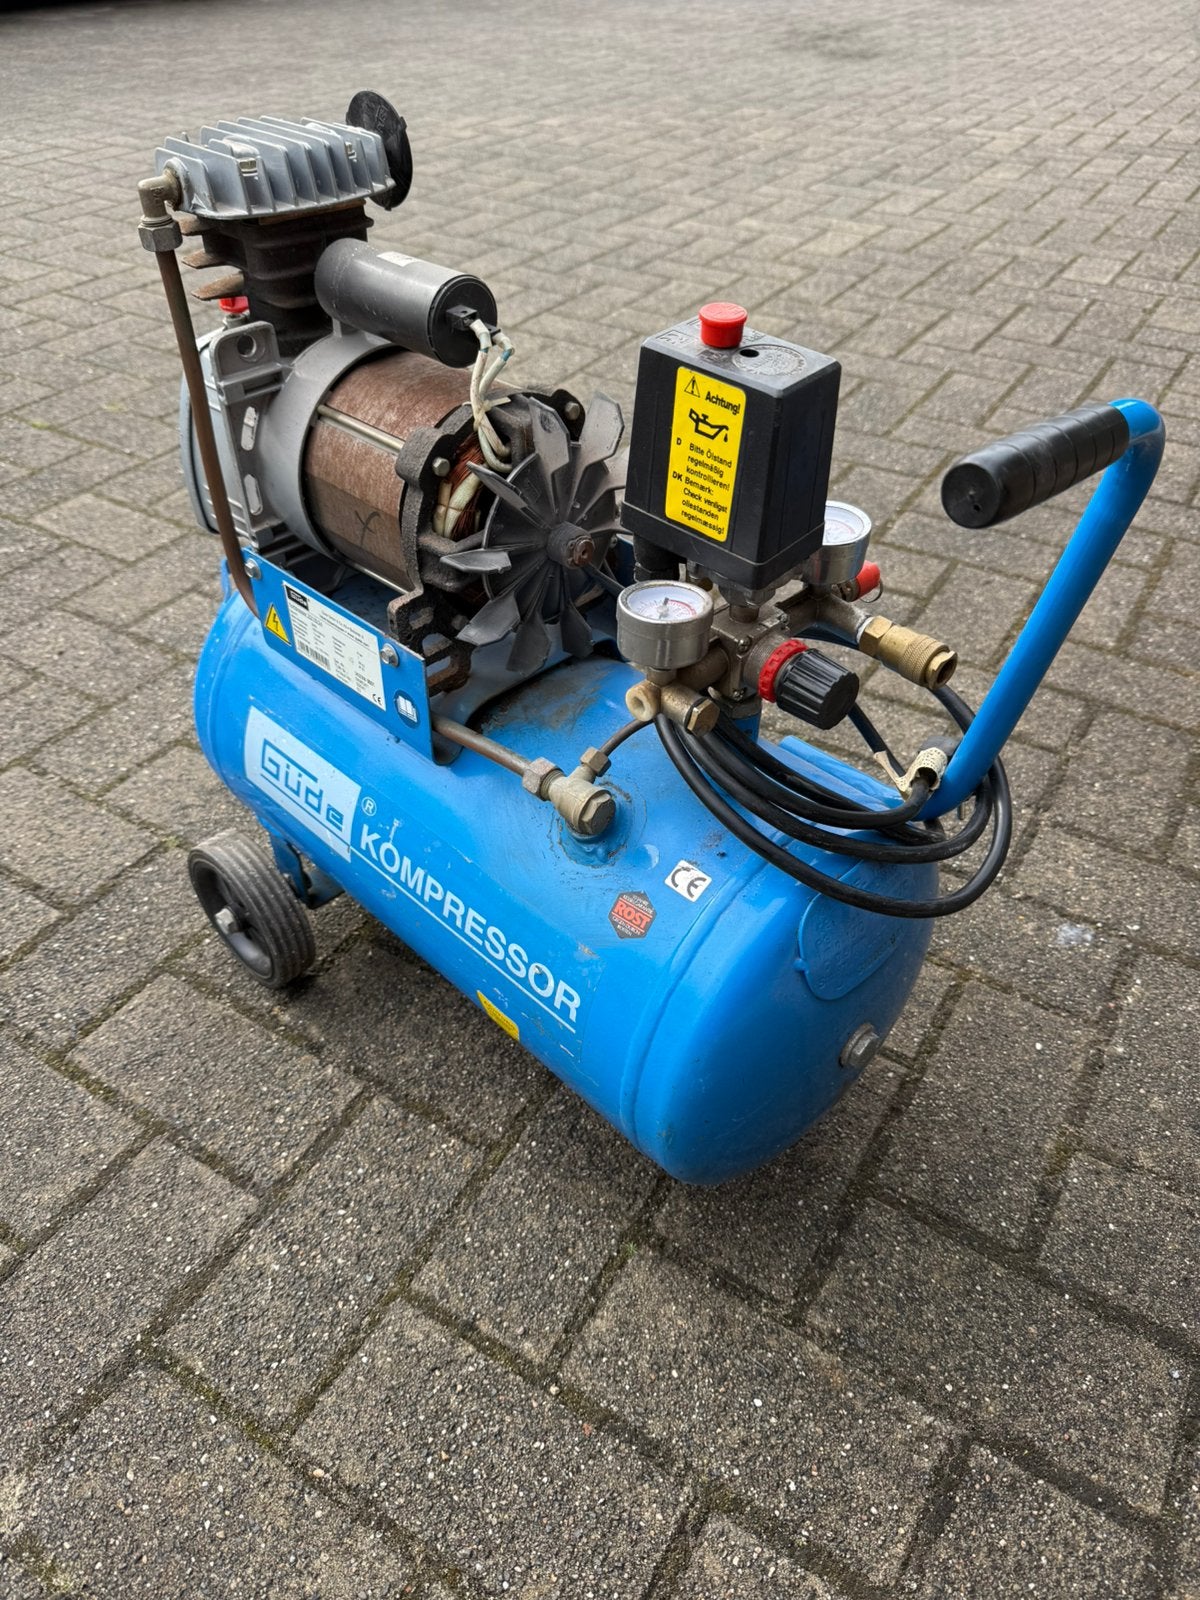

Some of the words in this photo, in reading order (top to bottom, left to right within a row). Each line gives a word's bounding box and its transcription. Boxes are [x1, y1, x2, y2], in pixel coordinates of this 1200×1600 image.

[705, 391, 741, 415] Achtung!
[676, 437, 682, 445] D
[690, 443, 705, 456] Bitte
[706, 448, 732, 468] Ölstand
[686, 465, 730, 491] kontrollieren!
[688, 456, 724, 478] regelmäßig
[672, 471, 683, 482] DK
[685, 476, 714, 495] Bemærk:
[682, 499, 719, 520] oliestanden
[683, 487, 702, 502] Check
[704, 498, 727, 513] venligst
[681, 510, 724, 534] regelmæssig!
[261, 738, 345, 832] Güde
[360, 824, 582, 1023] KOMPRESSOR
[613, 900, 652, 929] ROST
